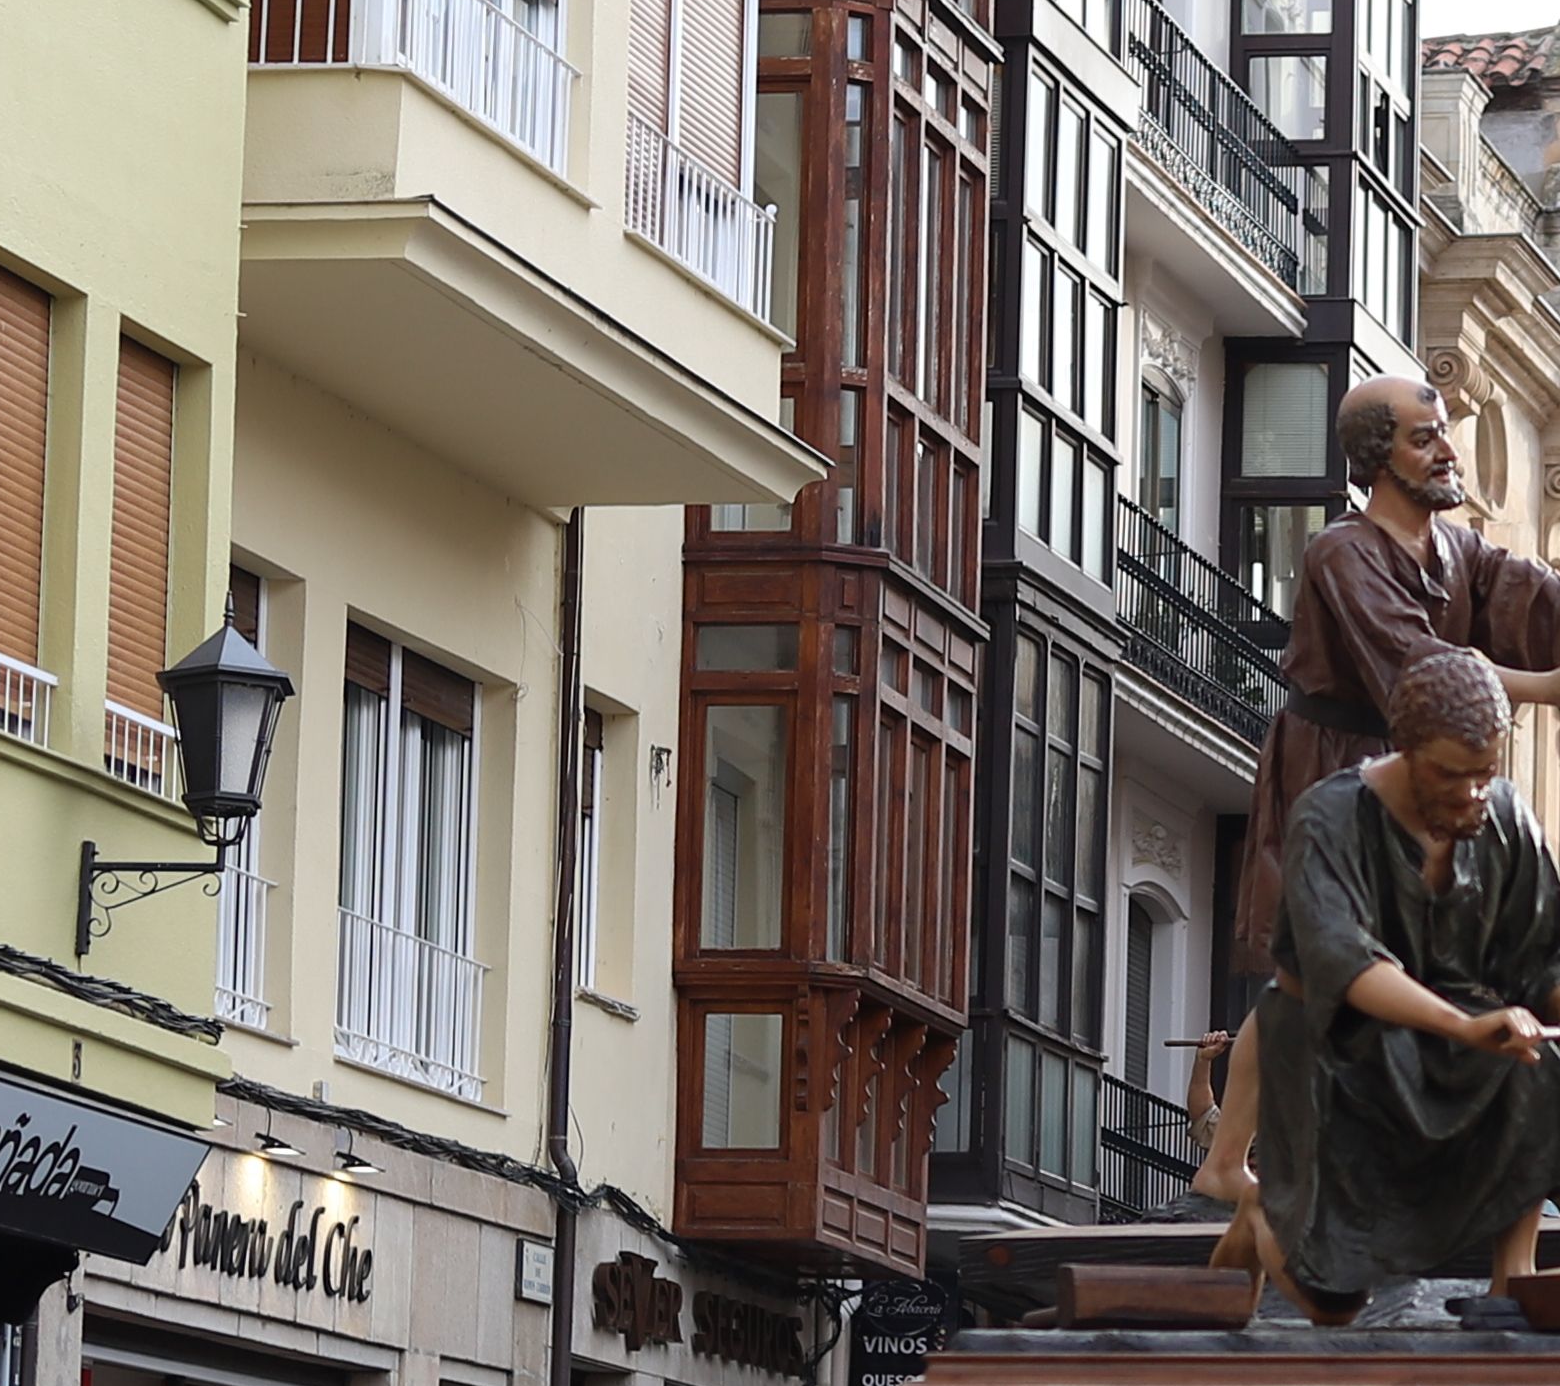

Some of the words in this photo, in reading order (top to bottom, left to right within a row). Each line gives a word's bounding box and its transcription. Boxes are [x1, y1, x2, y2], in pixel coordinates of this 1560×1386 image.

[274, 1200, 325, 1292] del
[323, 1215, 373, 1303] Che
[862, 1335, 928, 1354] VINOS
